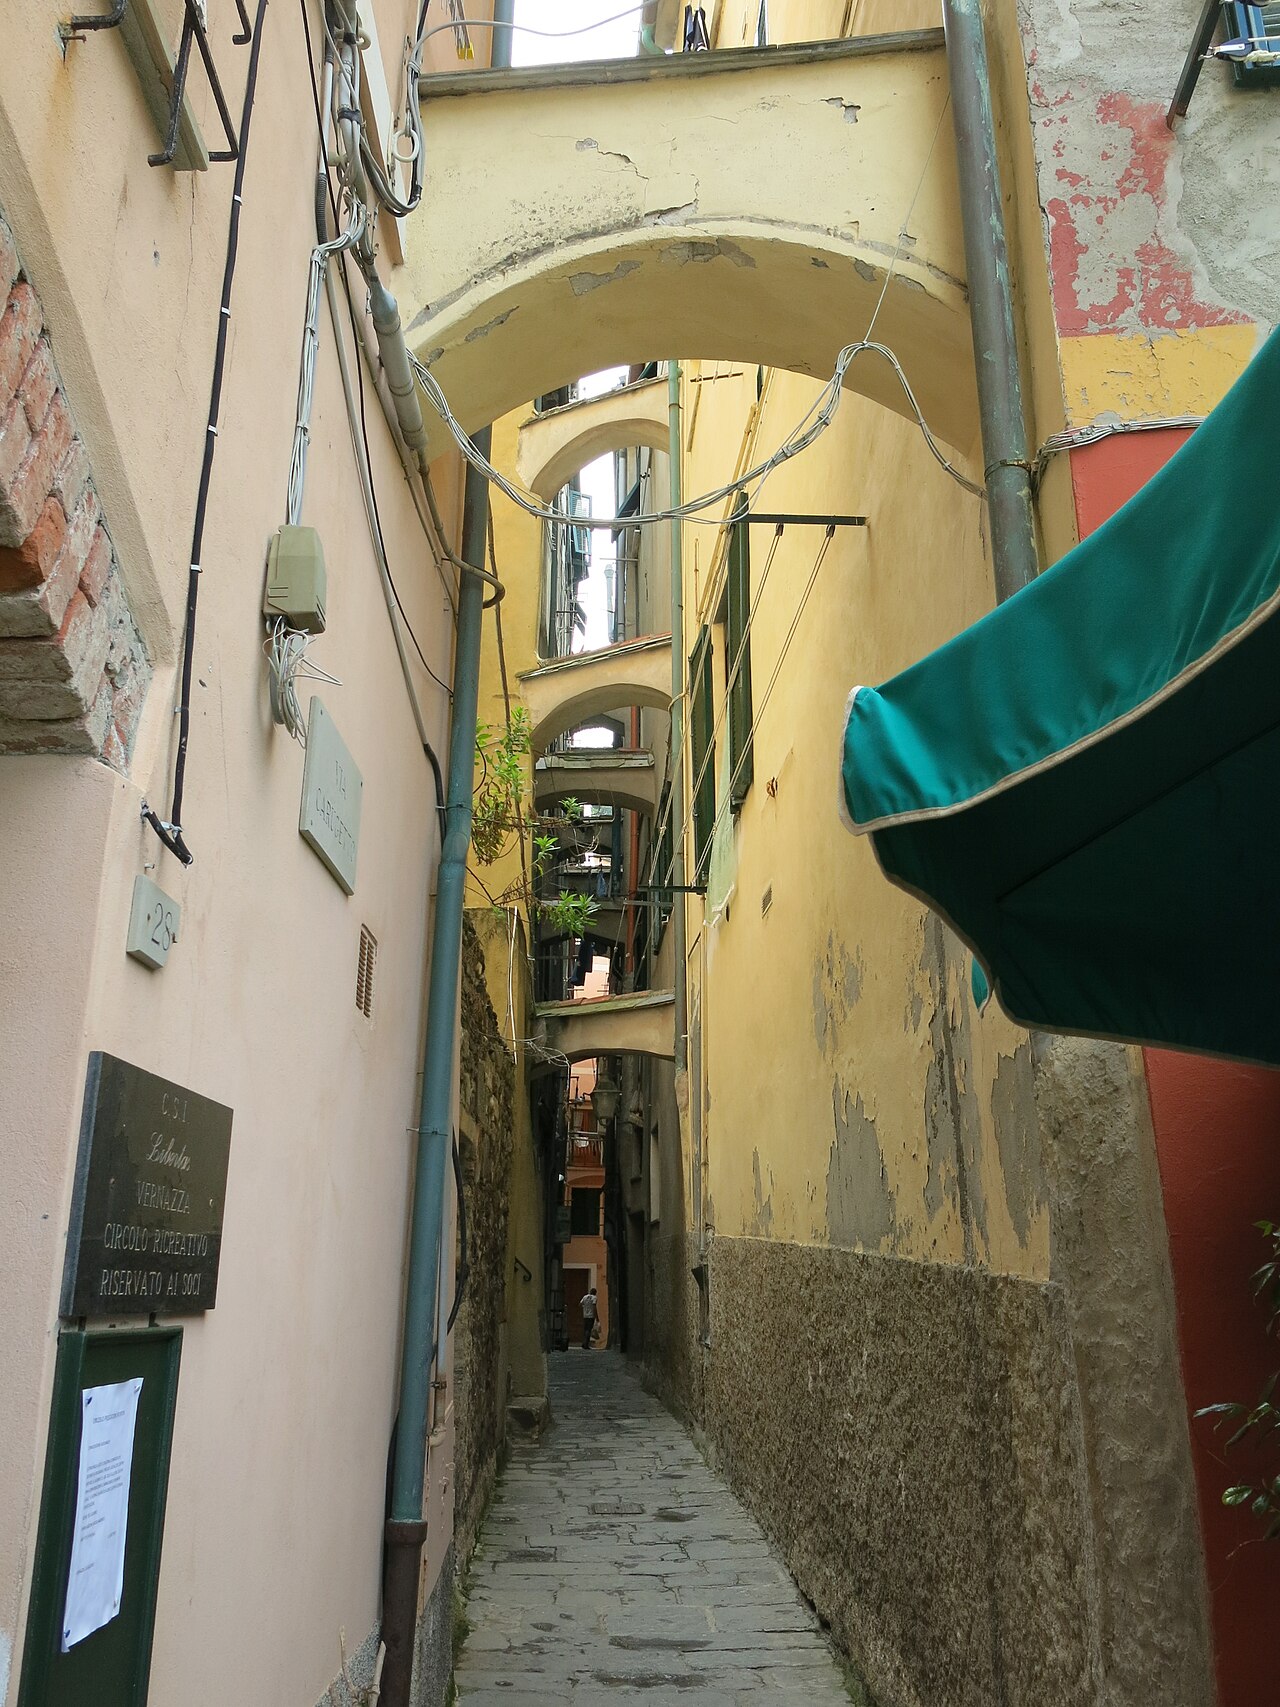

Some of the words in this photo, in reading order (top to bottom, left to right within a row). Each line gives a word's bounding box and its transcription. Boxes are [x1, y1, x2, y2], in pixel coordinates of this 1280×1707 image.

[335, 760, 347, 801] VIA
[151, 902, 172, 951] 28
[137, 1180, 190, 1214] VERNAZZA
[104, 1223, 148, 1252] CIRCOLO
[153, 1231, 208, 1257] RICREATIVO
[100, 1269, 162, 1296] RISERVATO
[166, 1273, 178, 1296] AI
[182, 1272, 202, 1296] SOCI
